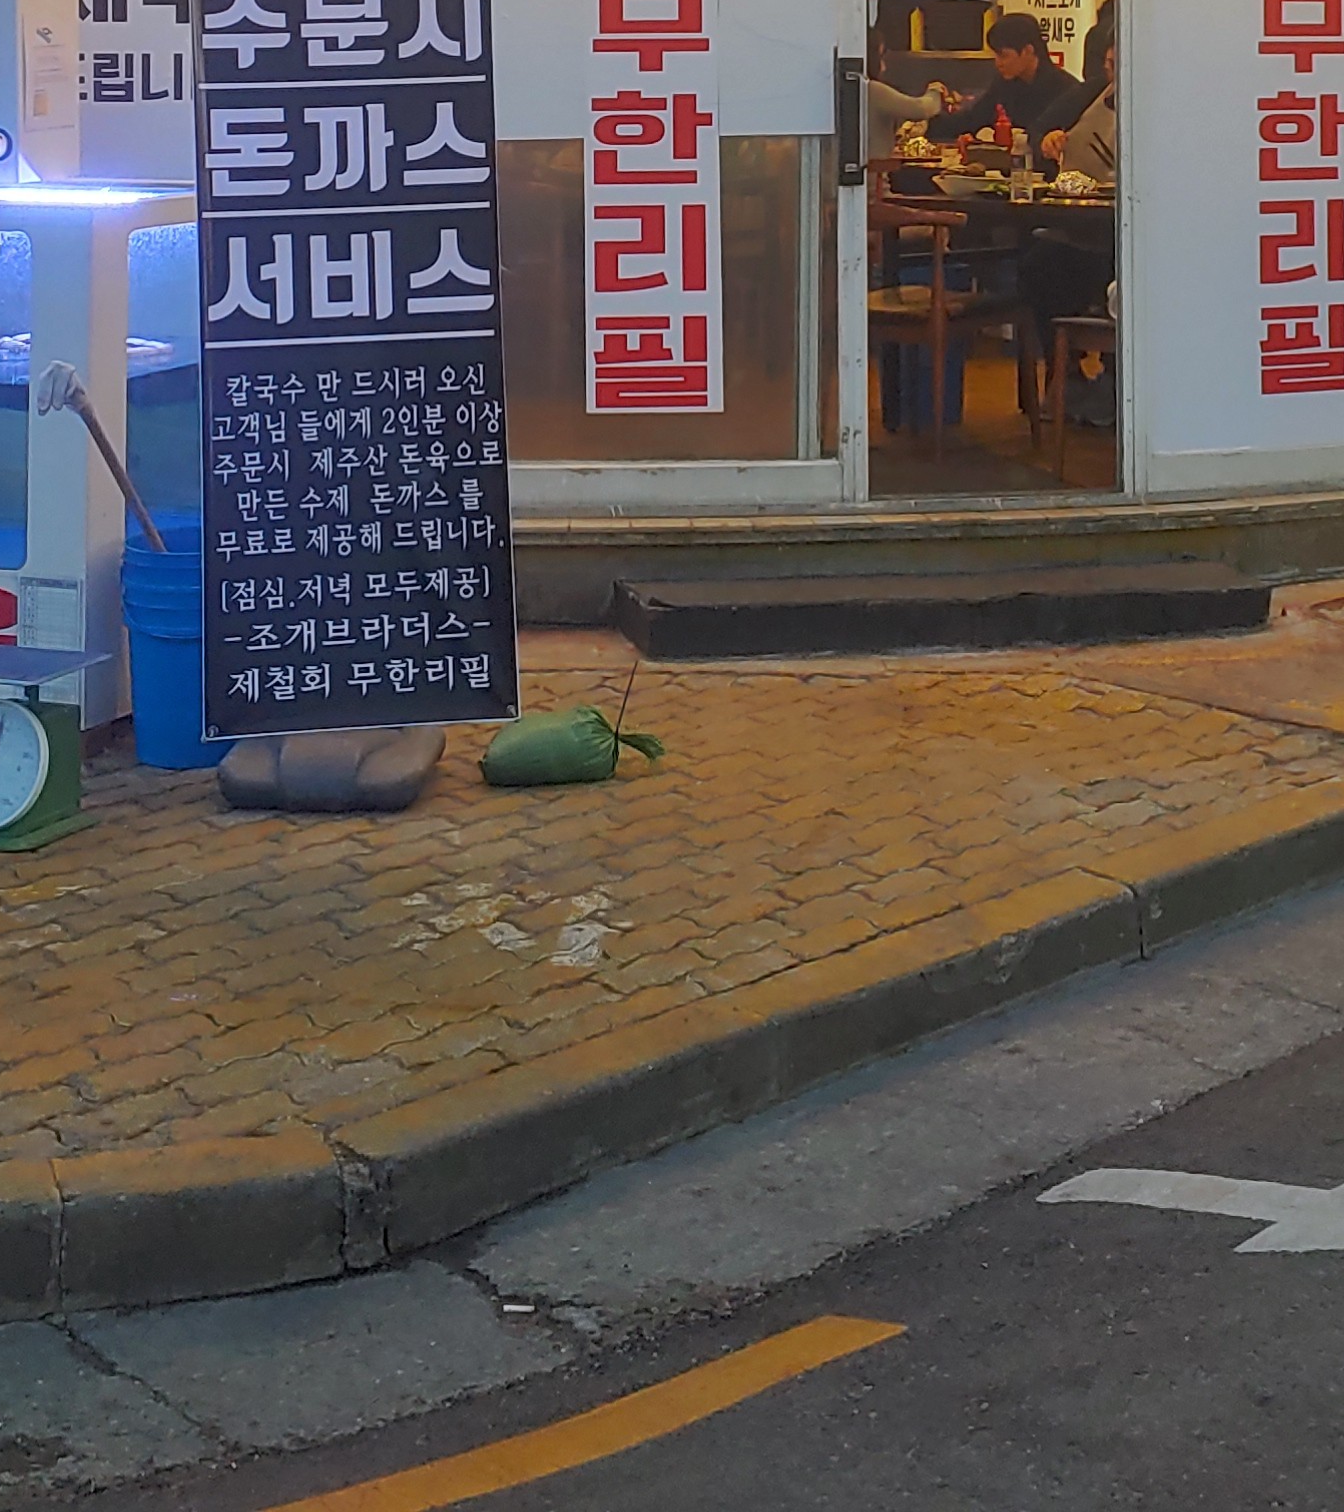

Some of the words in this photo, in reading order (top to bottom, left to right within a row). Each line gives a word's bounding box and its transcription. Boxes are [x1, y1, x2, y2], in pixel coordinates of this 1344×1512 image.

[204, 101, 491, 198] 돈까스
[207, 227, 496, 326] 서비스
[225, 372, 306, 407] 칼국수
[316, 370, 341, 401] 만
[352, 365, 427, 399] 드시러
[436, 362, 485, 395] 오신
[211, 410, 287, 444] 고객님
[297, 406, 372, 443] 들에게
[382, 403, 446, 436] 2인분
[456, 400, 502, 434] 이상
[212, 447, 291, 485] 주문시
[309, 444, 388, 479] 제주산
[398, 439, 503, 475] 돈육으로
[237, 486, 289, 523] 만든
[299, 484, 350, 519] 수제
[369, 481, 449, 515] 돈까스
[458, 477, 484, 511] 를
[215, 528, 295, 563] 무료로
[305, 523, 383, 558] 제공해
[392, 514, 505, 552] 드립니다.
[224, 611, 491, 654] -조개브라더스-
[228, 662, 331, 704] 제철회
[347, 653, 491, 696] 무한리필
